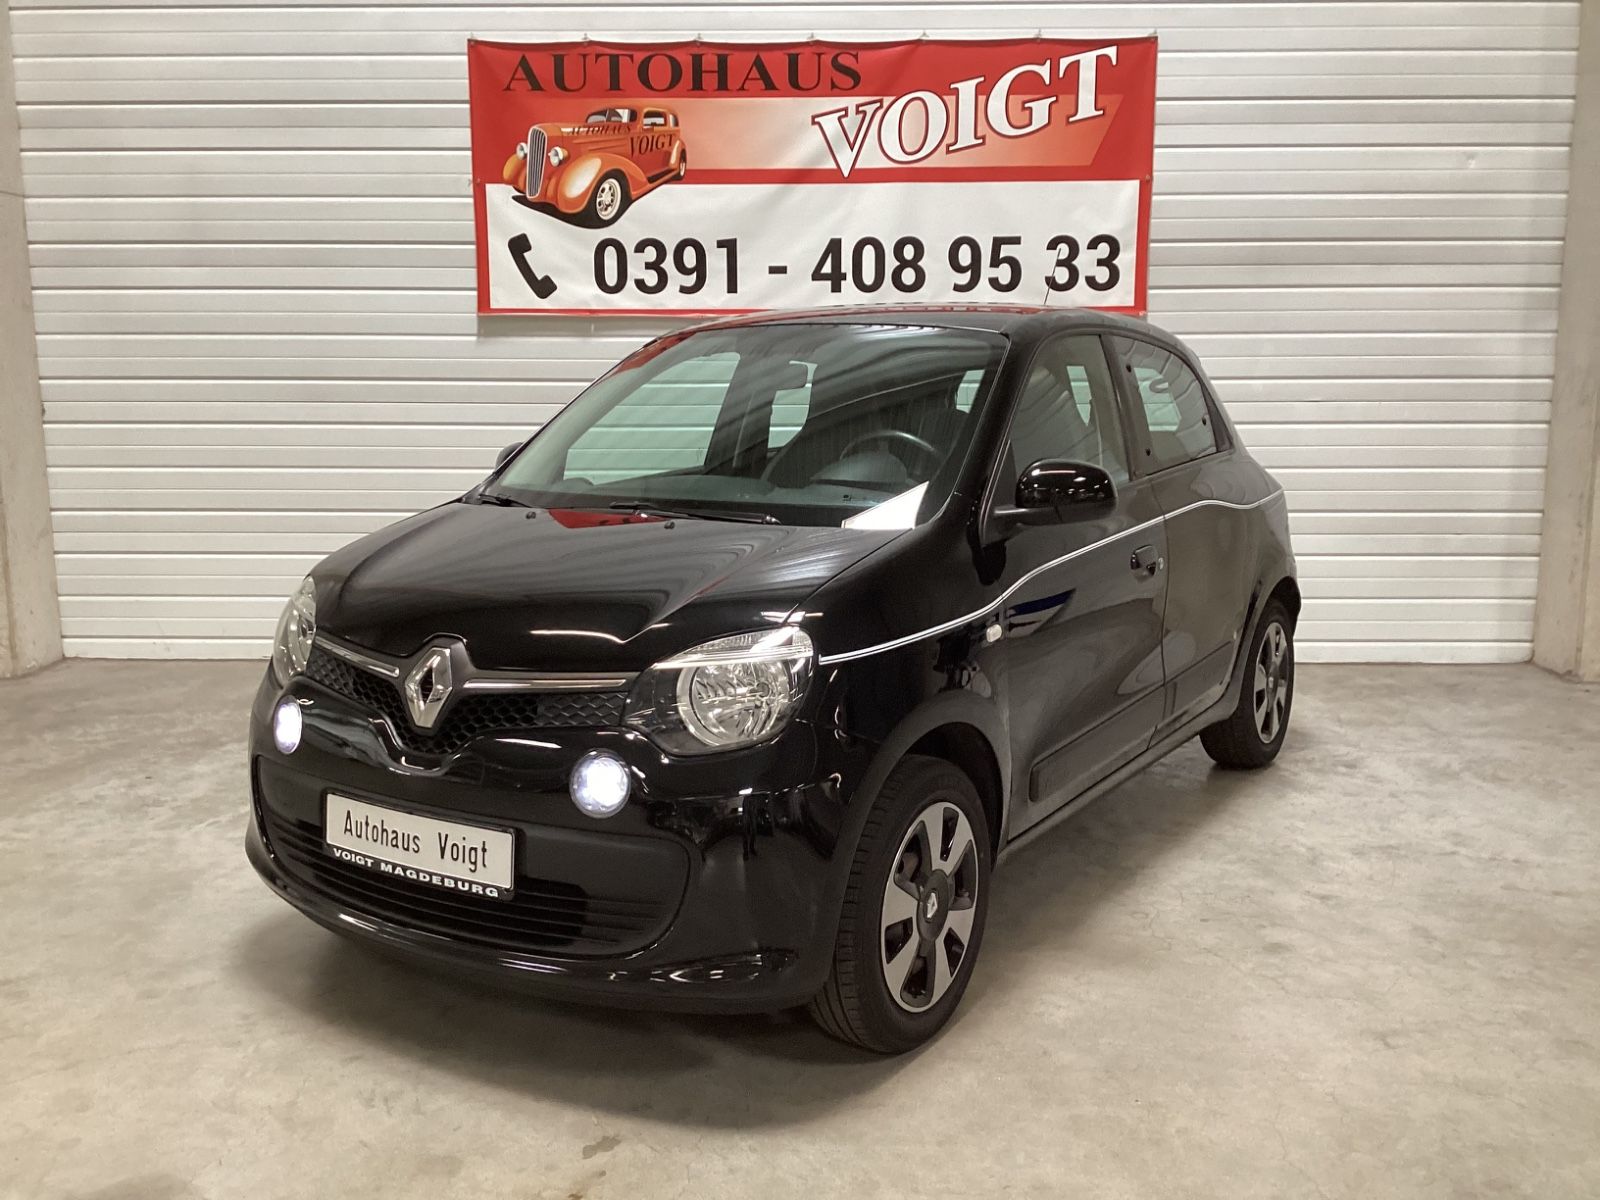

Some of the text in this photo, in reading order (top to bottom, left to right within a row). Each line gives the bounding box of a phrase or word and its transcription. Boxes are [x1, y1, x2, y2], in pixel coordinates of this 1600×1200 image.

[502, 44, 1118, 179] AUTOHAUS VOIGT
[629, 133, 675, 157] VOIGT
[593, 235, 1121, 294] 0391 - 408 95 33
[343, 810, 487, 873] Autohaus Voigt
[333, 848, 499, 898] VOIGT MAGDEBURG
